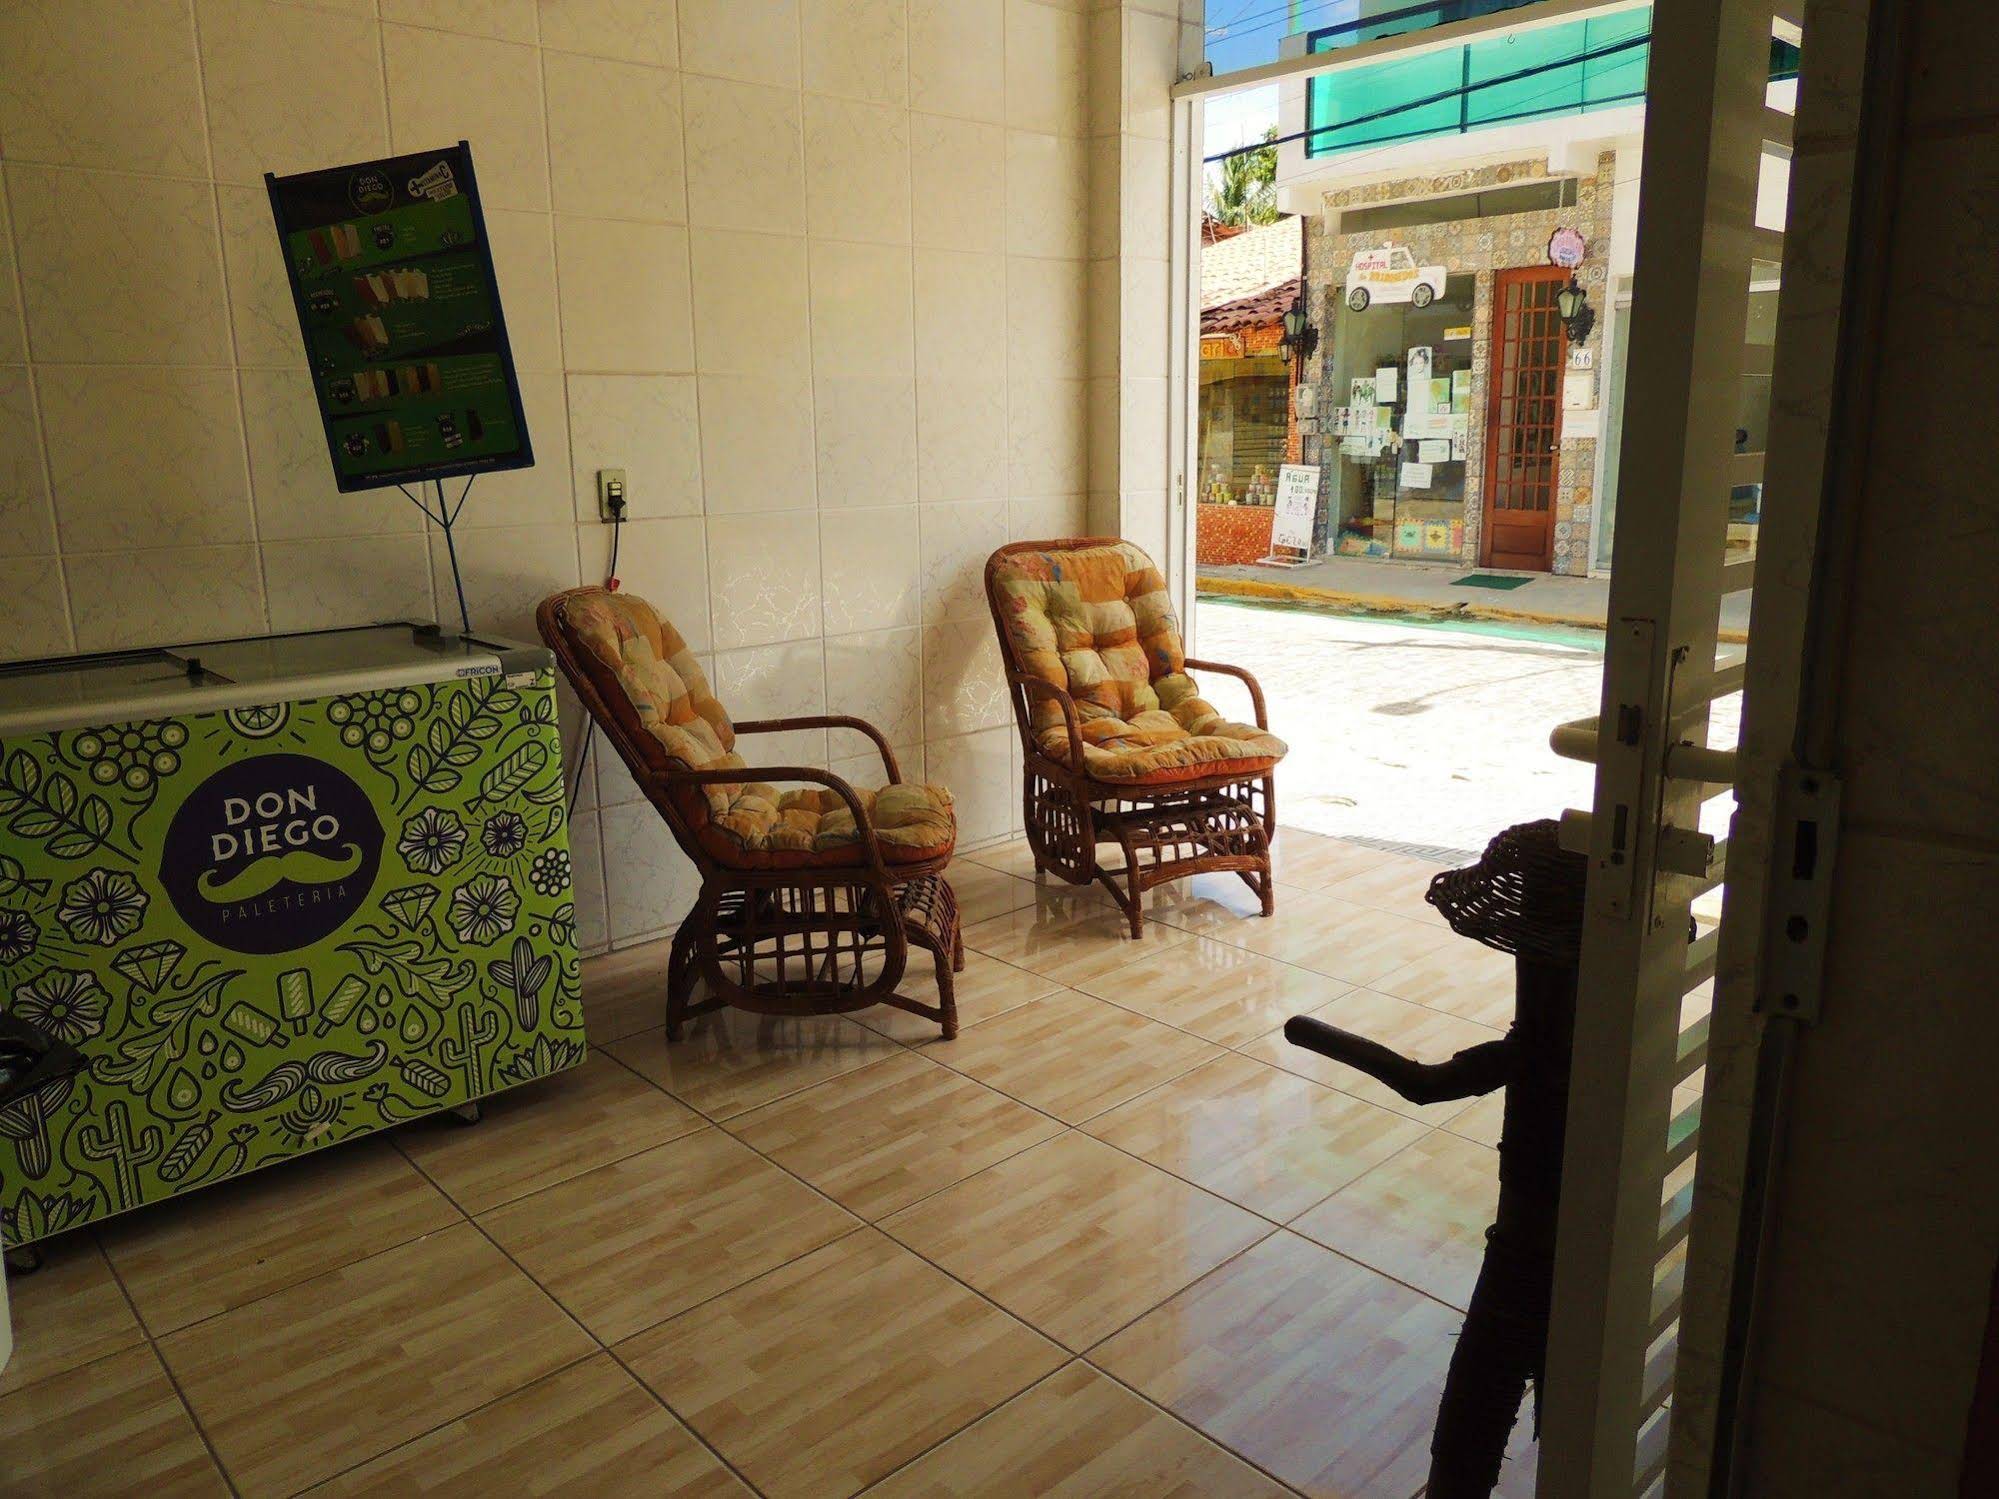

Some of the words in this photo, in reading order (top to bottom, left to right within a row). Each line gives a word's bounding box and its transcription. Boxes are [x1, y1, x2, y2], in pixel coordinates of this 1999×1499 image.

[1355, 260, 1387, 270] HOSPITAL
[1574, 351, 1591, 366] 66
[223, 784, 317, 826] DON
[211, 814, 340, 862] DIEGO
[222, 885, 346, 923] PALETERIA
